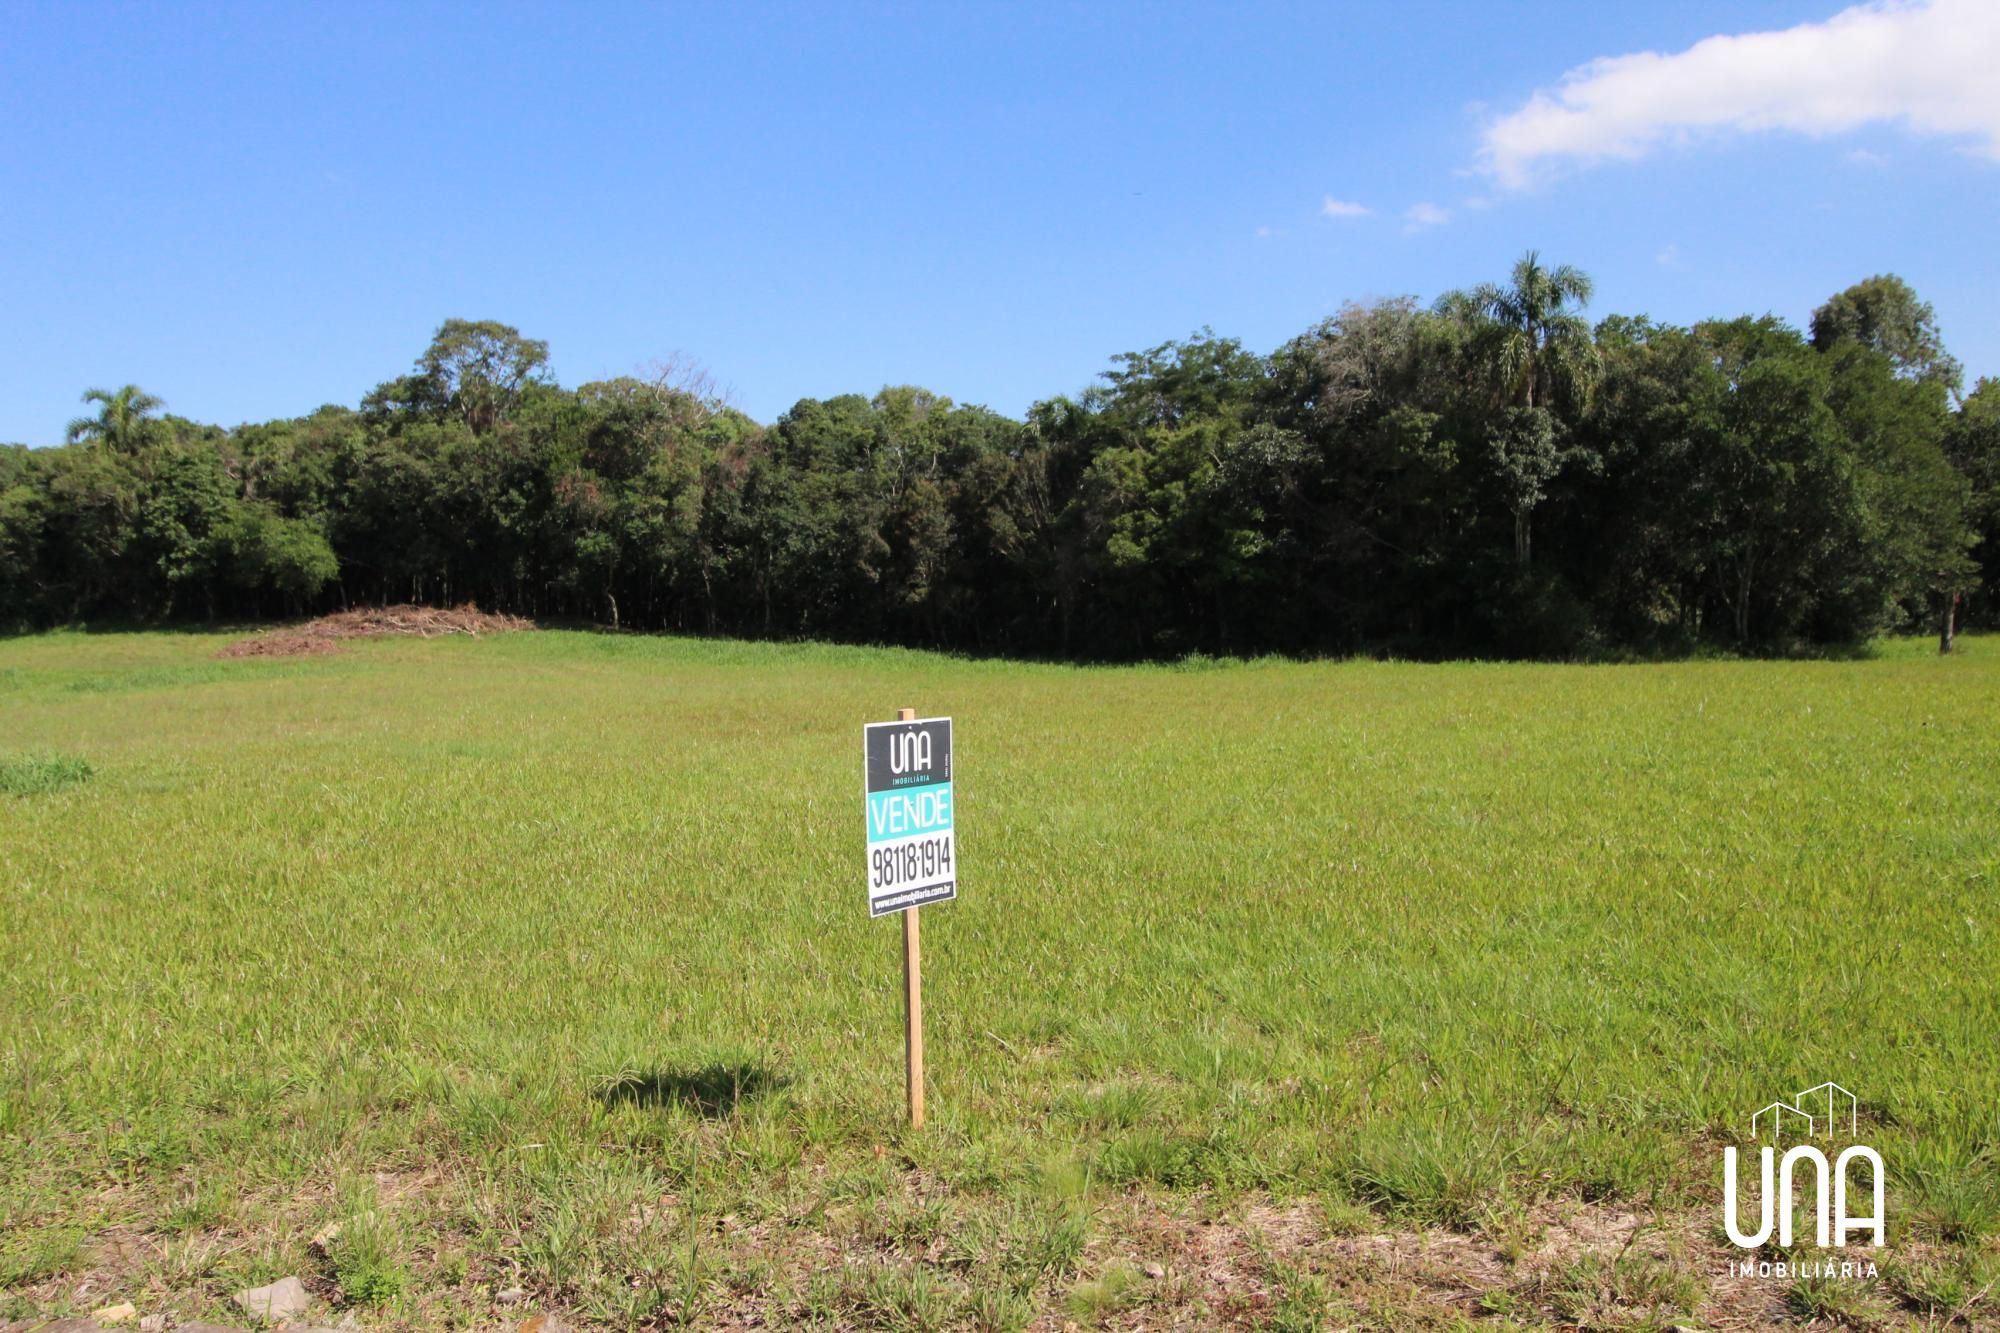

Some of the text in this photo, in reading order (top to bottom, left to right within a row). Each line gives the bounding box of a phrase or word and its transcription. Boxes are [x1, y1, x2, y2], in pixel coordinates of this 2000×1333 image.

[890, 731, 931, 774] UNA
[893, 775, 930, 786] IMOBILIÁRIA
[871, 789, 949, 836] VENDE
